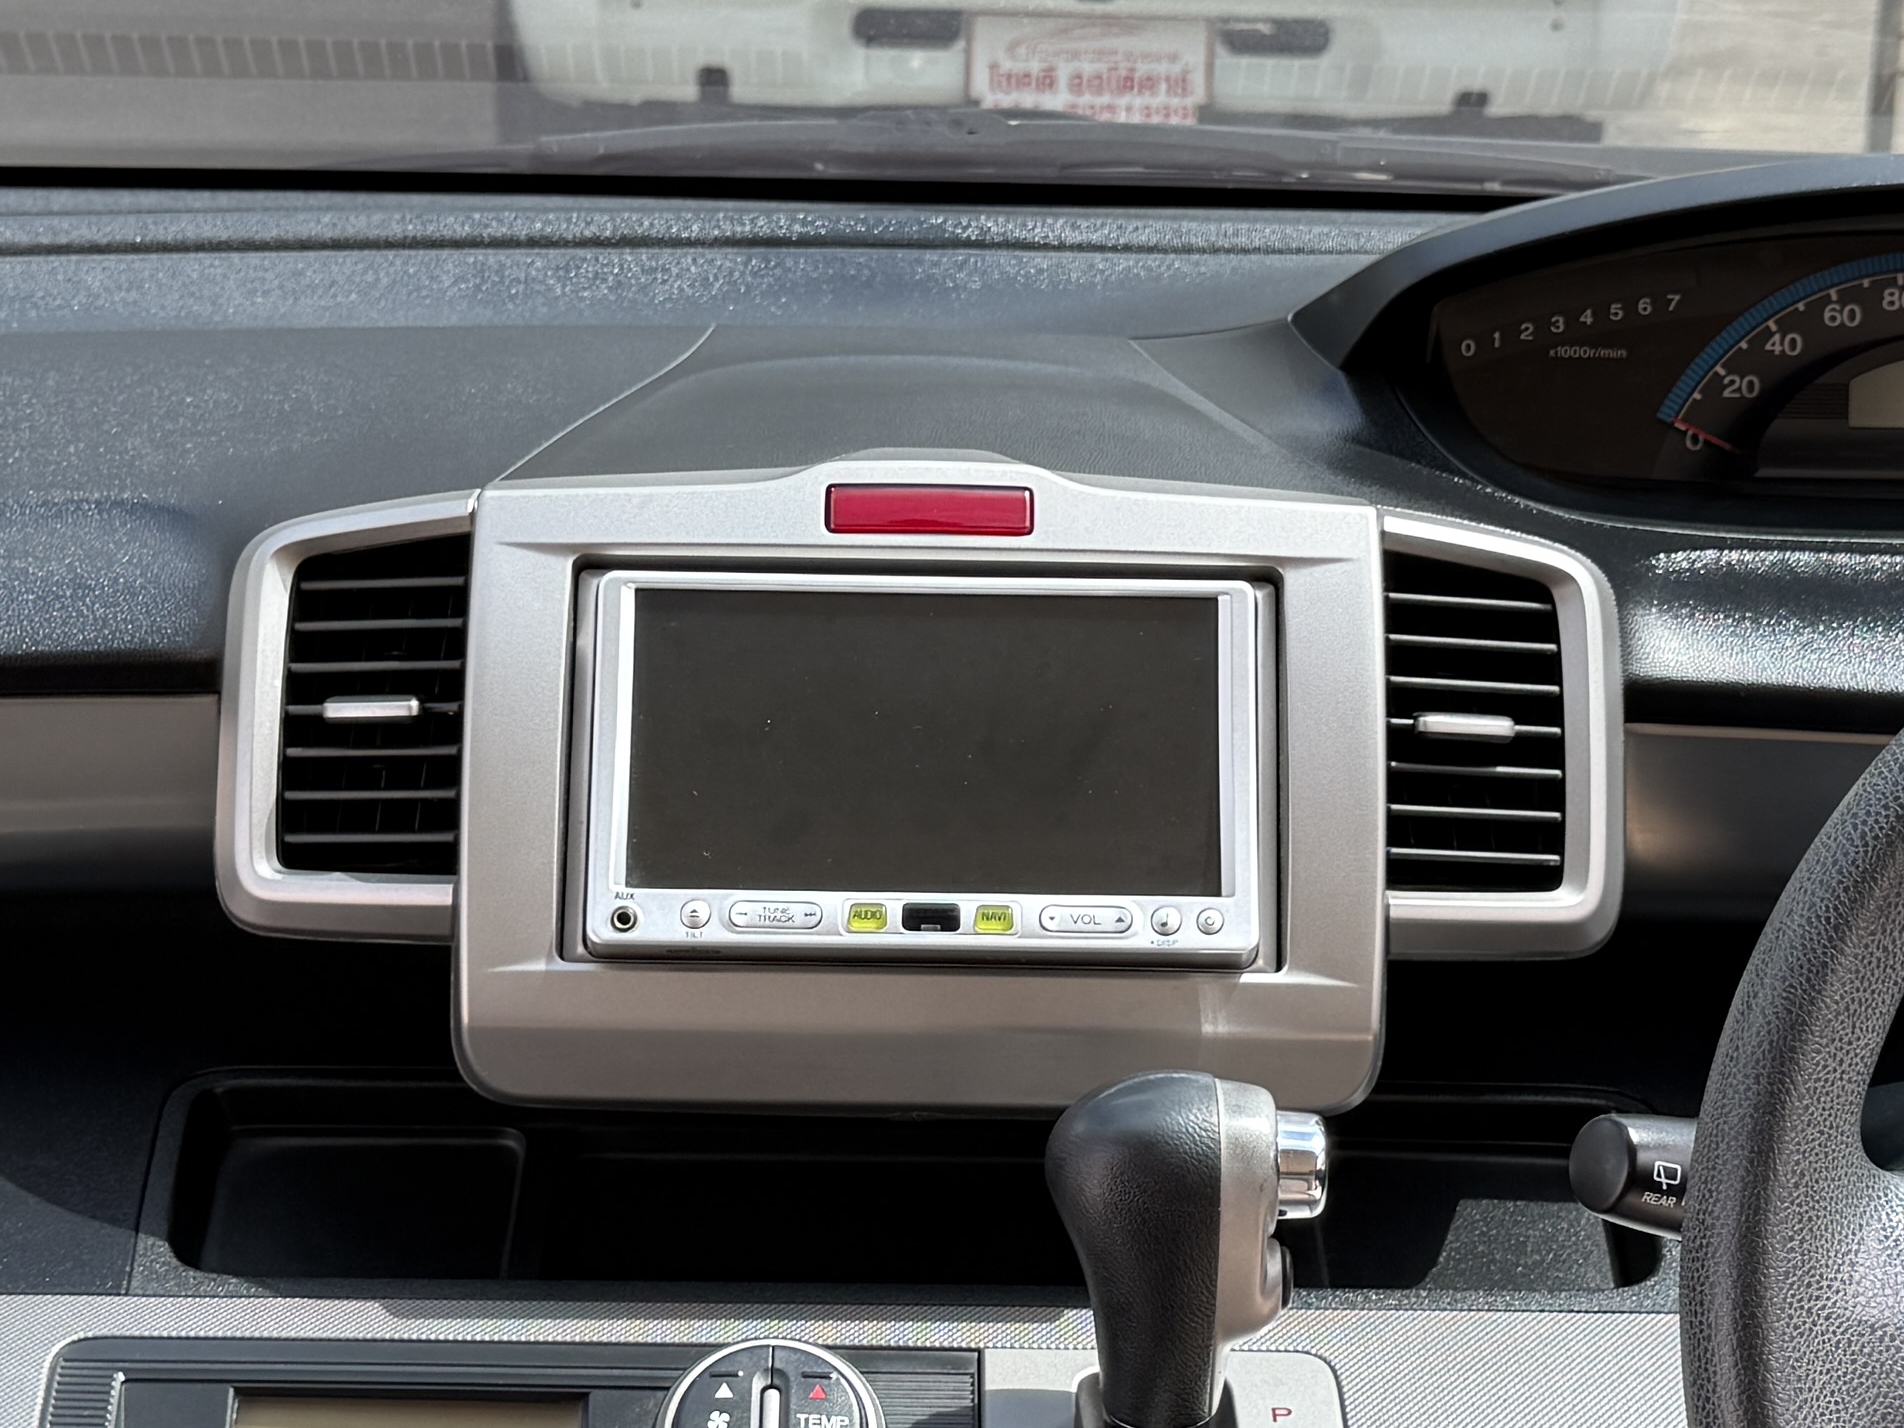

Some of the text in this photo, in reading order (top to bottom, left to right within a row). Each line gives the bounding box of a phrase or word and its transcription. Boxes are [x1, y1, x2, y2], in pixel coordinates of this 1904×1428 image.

[1460, 294, 1681, 357] 0 1 2 3 4 5 6 7
[1722, 375, 1760, 398] 20
[1764, 333, 1803, 356] 40
[1823, 304, 1861, 327] 60
[614, 892, 635, 901] AUX
[757, 914, 795, 924] TRACK
[852, 909, 883, 920] AUDIO
[981, 911, 1007, 922] NAVI
[1069, 913, 1102, 925] VOL
[1642, 1192, 1677, 1208] REAR
[1271, 1407, 1293, 1423] P
